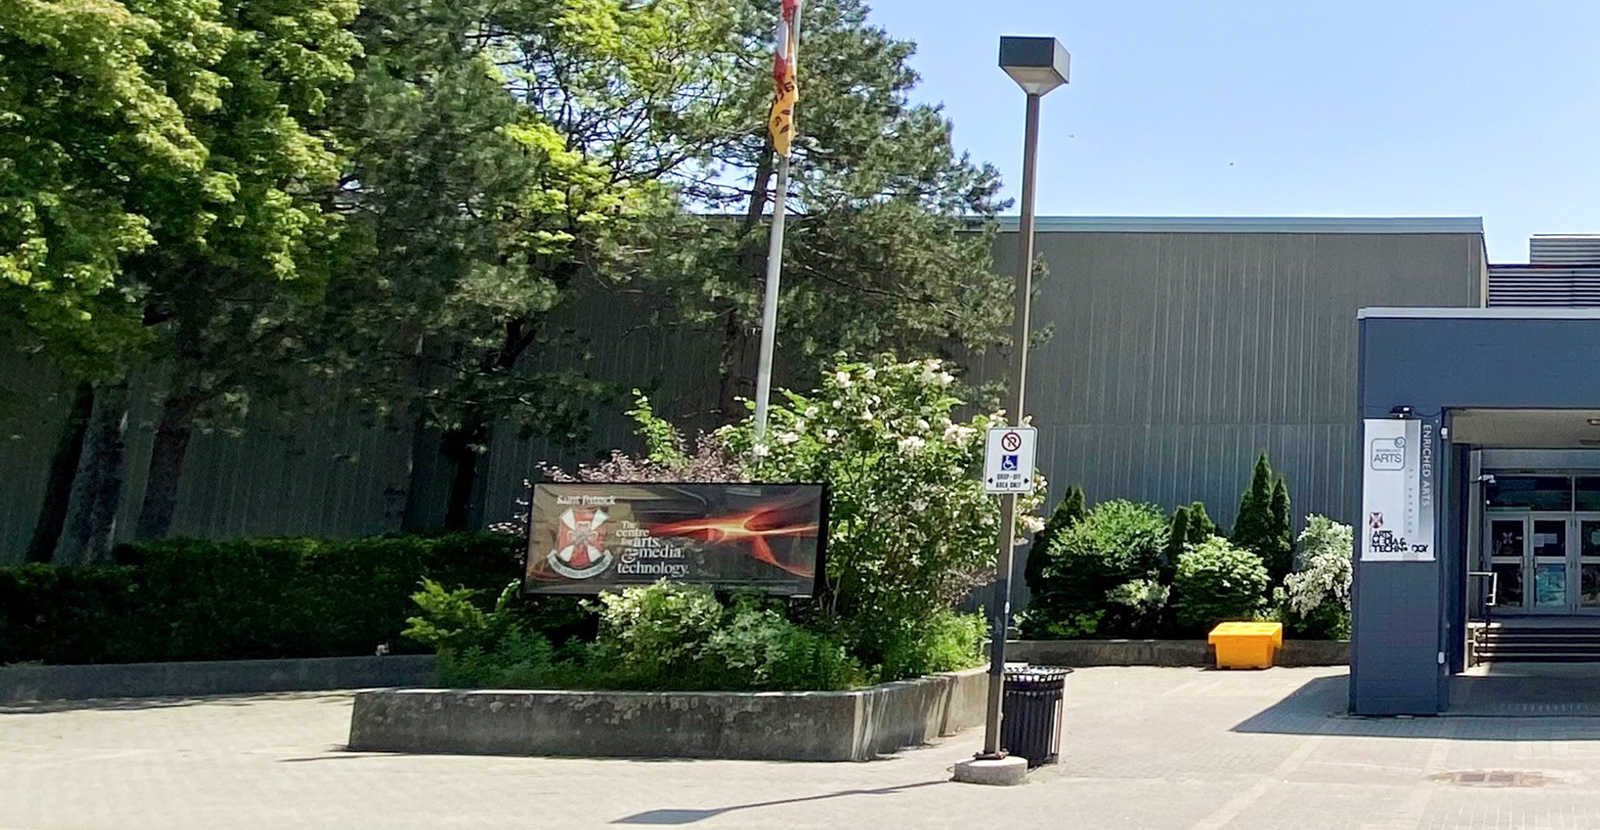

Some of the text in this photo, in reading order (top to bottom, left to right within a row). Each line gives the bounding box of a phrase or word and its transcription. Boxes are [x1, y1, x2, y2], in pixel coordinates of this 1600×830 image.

[1373, 453, 1402, 463] ARTS
[1421, 424, 1432, 507] ENRICHED ARTS
[556, 494, 616, 506] Saint Patrick
[621, 521, 637, 529] The
[616, 529, 650, 537] centre
[1372, 530, 1393, 538] ARTS
[621, 548, 638, 563] &
